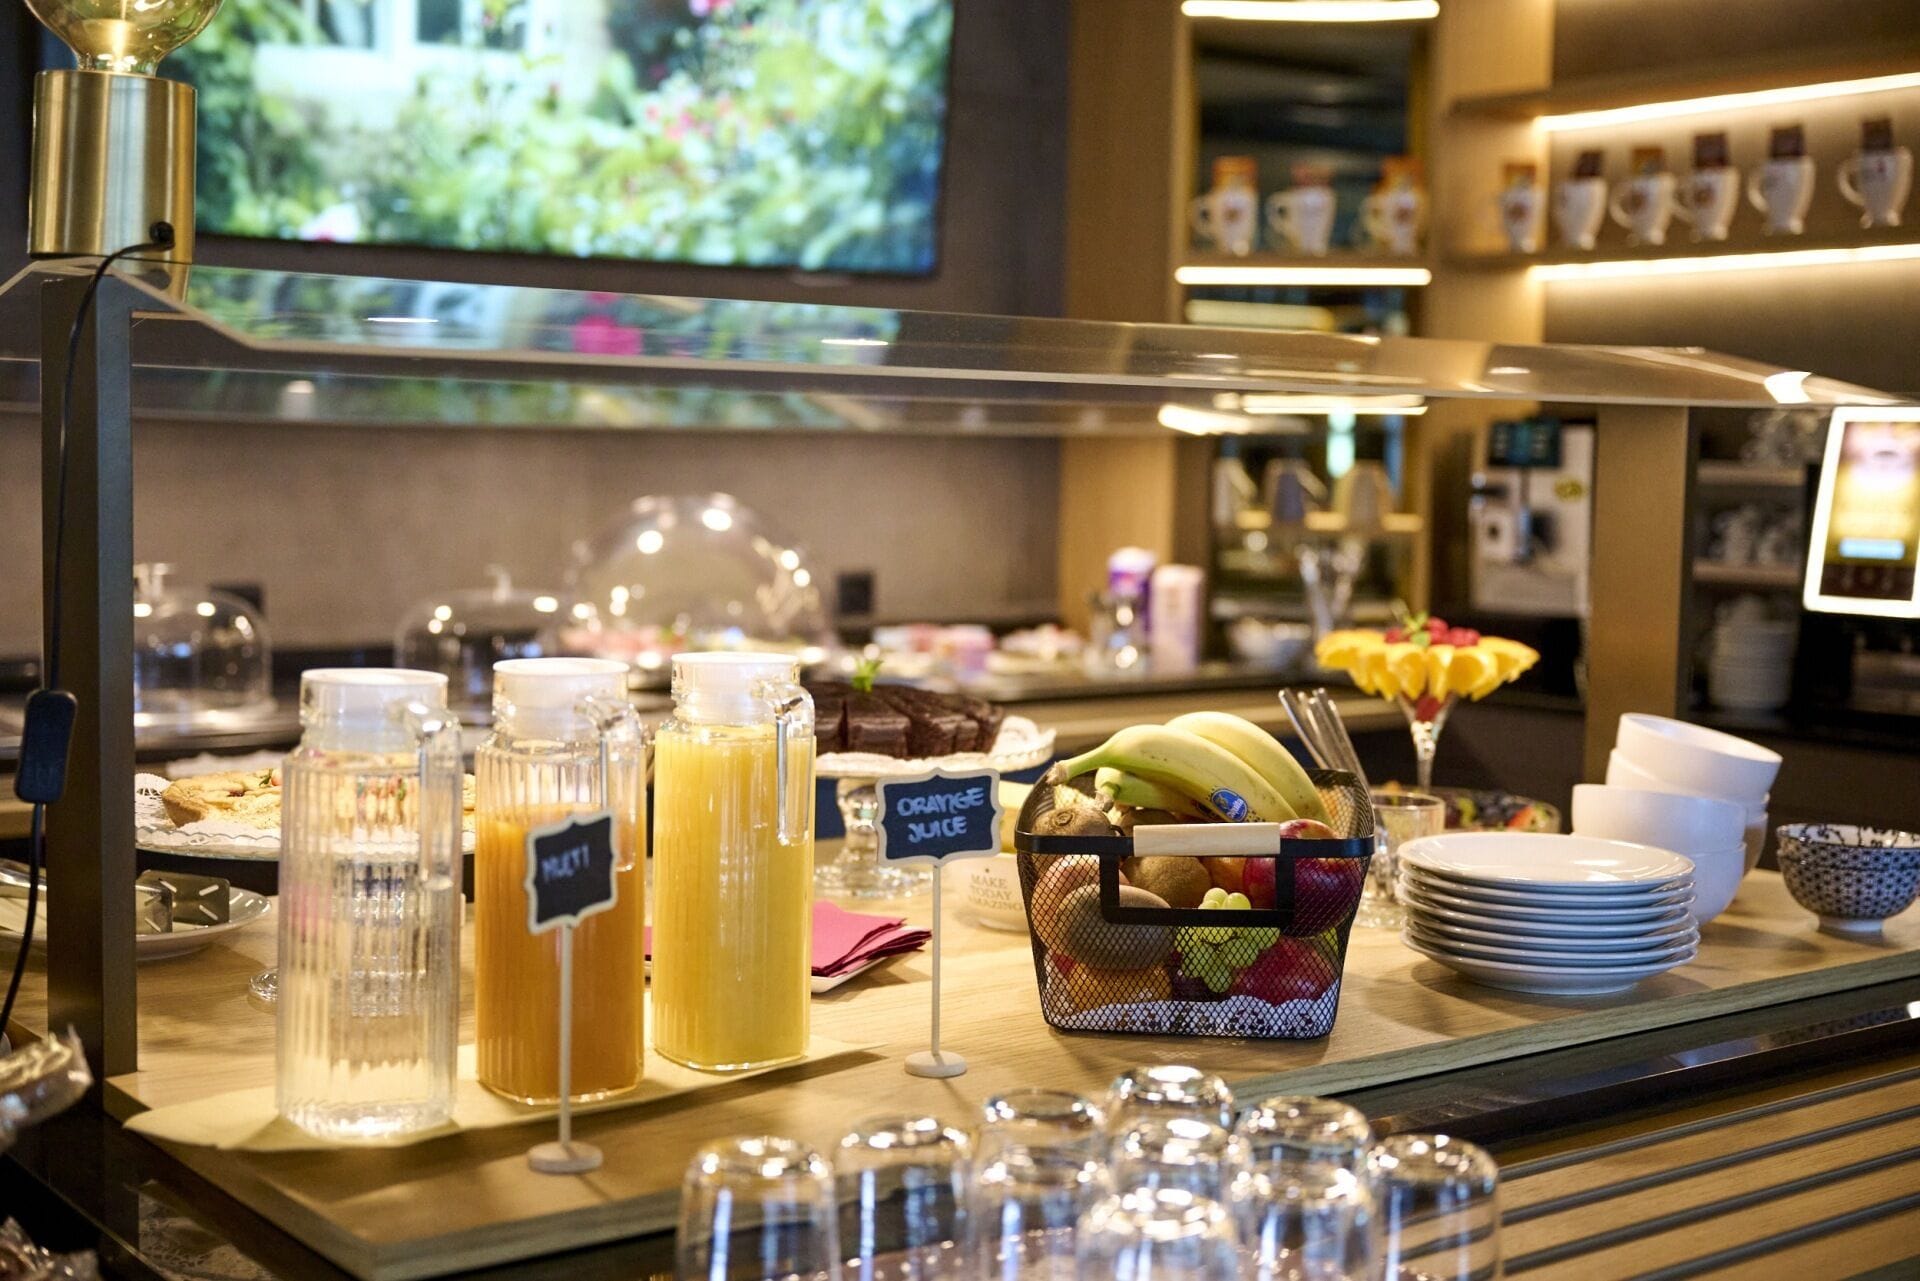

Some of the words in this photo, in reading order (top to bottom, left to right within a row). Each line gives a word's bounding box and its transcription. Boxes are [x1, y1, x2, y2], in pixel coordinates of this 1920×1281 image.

[896, 787, 985, 817] ORANGE
[907, 815, 968, 843] JUICE
[969, 884, 1013, 901] TODAY
[970, 873, 1008, 890] MAKE
